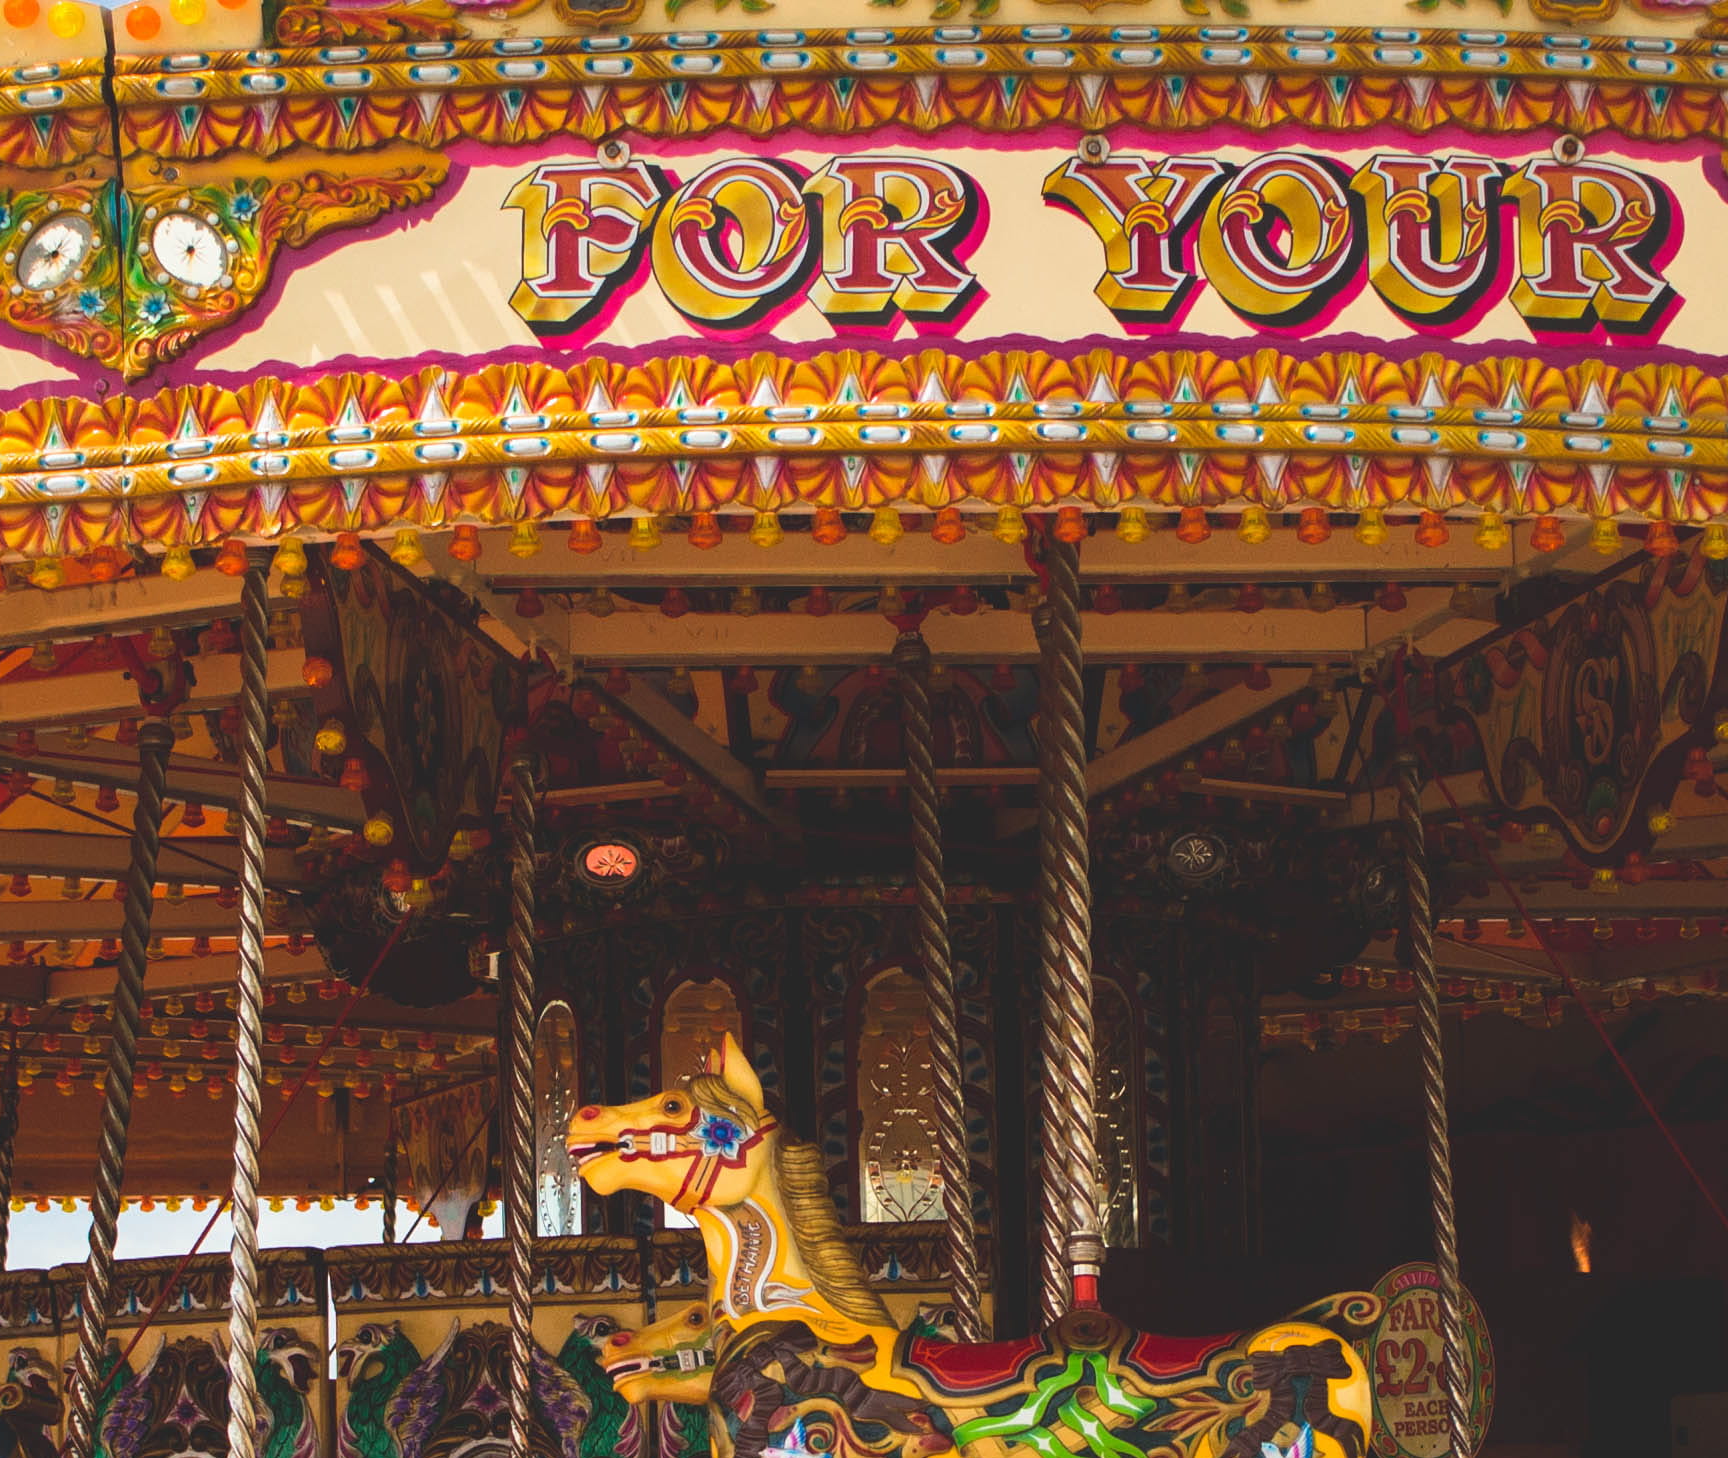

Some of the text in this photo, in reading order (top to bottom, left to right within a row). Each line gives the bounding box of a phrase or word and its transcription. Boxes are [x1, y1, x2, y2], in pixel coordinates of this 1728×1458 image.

[501, 152, 1683, 342] FOR YOUR
[1388, 1297, 1444, 1337] FAR
[1404, 1400, 1449, 1418] EACH
[1394, 1419, 1450, 1437] PERSO
